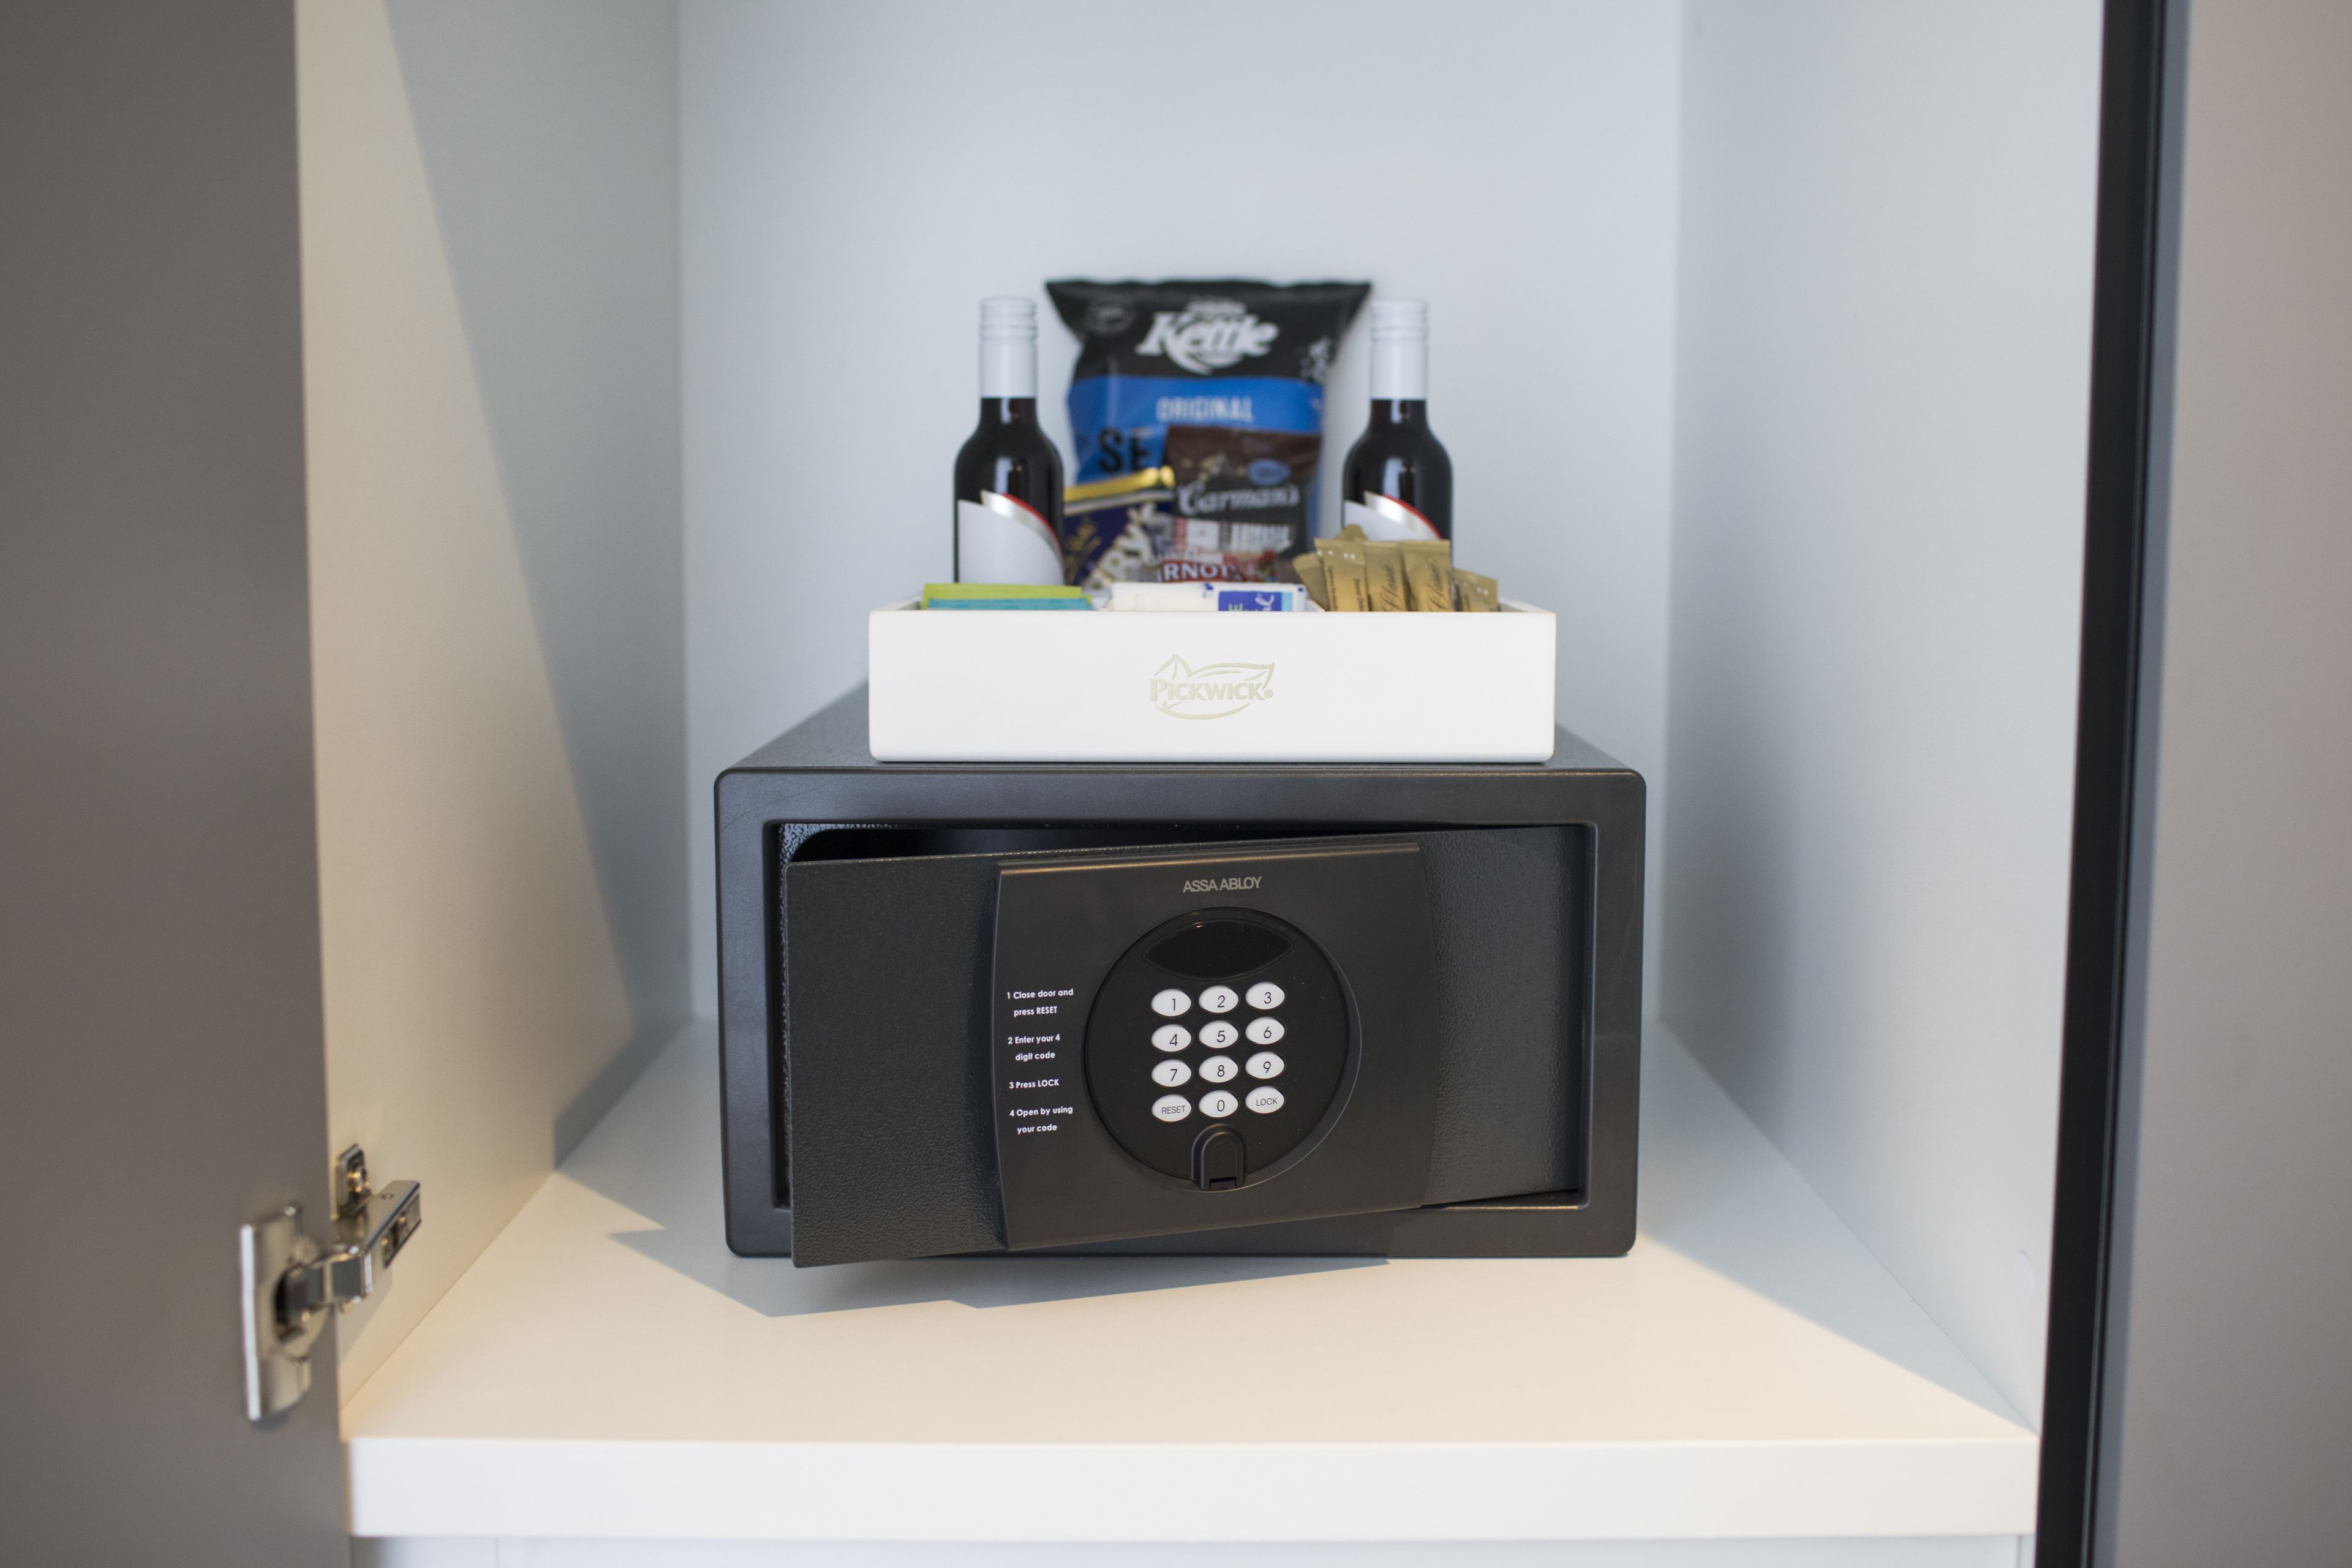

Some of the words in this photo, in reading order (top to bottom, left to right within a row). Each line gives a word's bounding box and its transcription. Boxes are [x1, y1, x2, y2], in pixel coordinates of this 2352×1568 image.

[1156, 396, 1254, 423] ORIGINAL
[1149, 678, 1266, 702] PICKWICK
[1182, 880, 1219, 893] ASSA
[1219, 876, 1262, 891] ABLOY
[1058, 988, 1074, 997] and
[1264, 992, 1272, 1005] 3
[1171, 998, 1175, 1011] 1
[1217, 995, 1226, 1008] 2
[1014, 1009, 1035, 1017] press
[1036, 1006, 1058, 1014] RESET
[1216, 1030, 1226, 1043] 5
[1263, 1026, 1272, 1039] 6
[1036, 1035, 1054, 1044] your
[1169, 1033, 1178, 1047] 4
[1015, 1053, 1033, 1062] digit
[1035, 1051, 1055, 1060] code
[1216, 1065, 1225, 1077] 8
[1263, 1061, 1272, 1074] 9
[1170, 1068, 1178, 1082] 7
[1038, 1079, 1059, 1087] LOCK
[1216, 1099, 1225, 1112] 0
[1256, 1098, 1278, 1107] LOCK
[1016, 1109, 1038, 1118] Open
[1041, 1107, 1050, 1116] by
[1053, 1106, 1073, 1114] using
[1161, 1105, 1186, 1115] RESET
[1017, 1126, 1035, 1135] your
[1036, 1123, 1058, 1133] code
